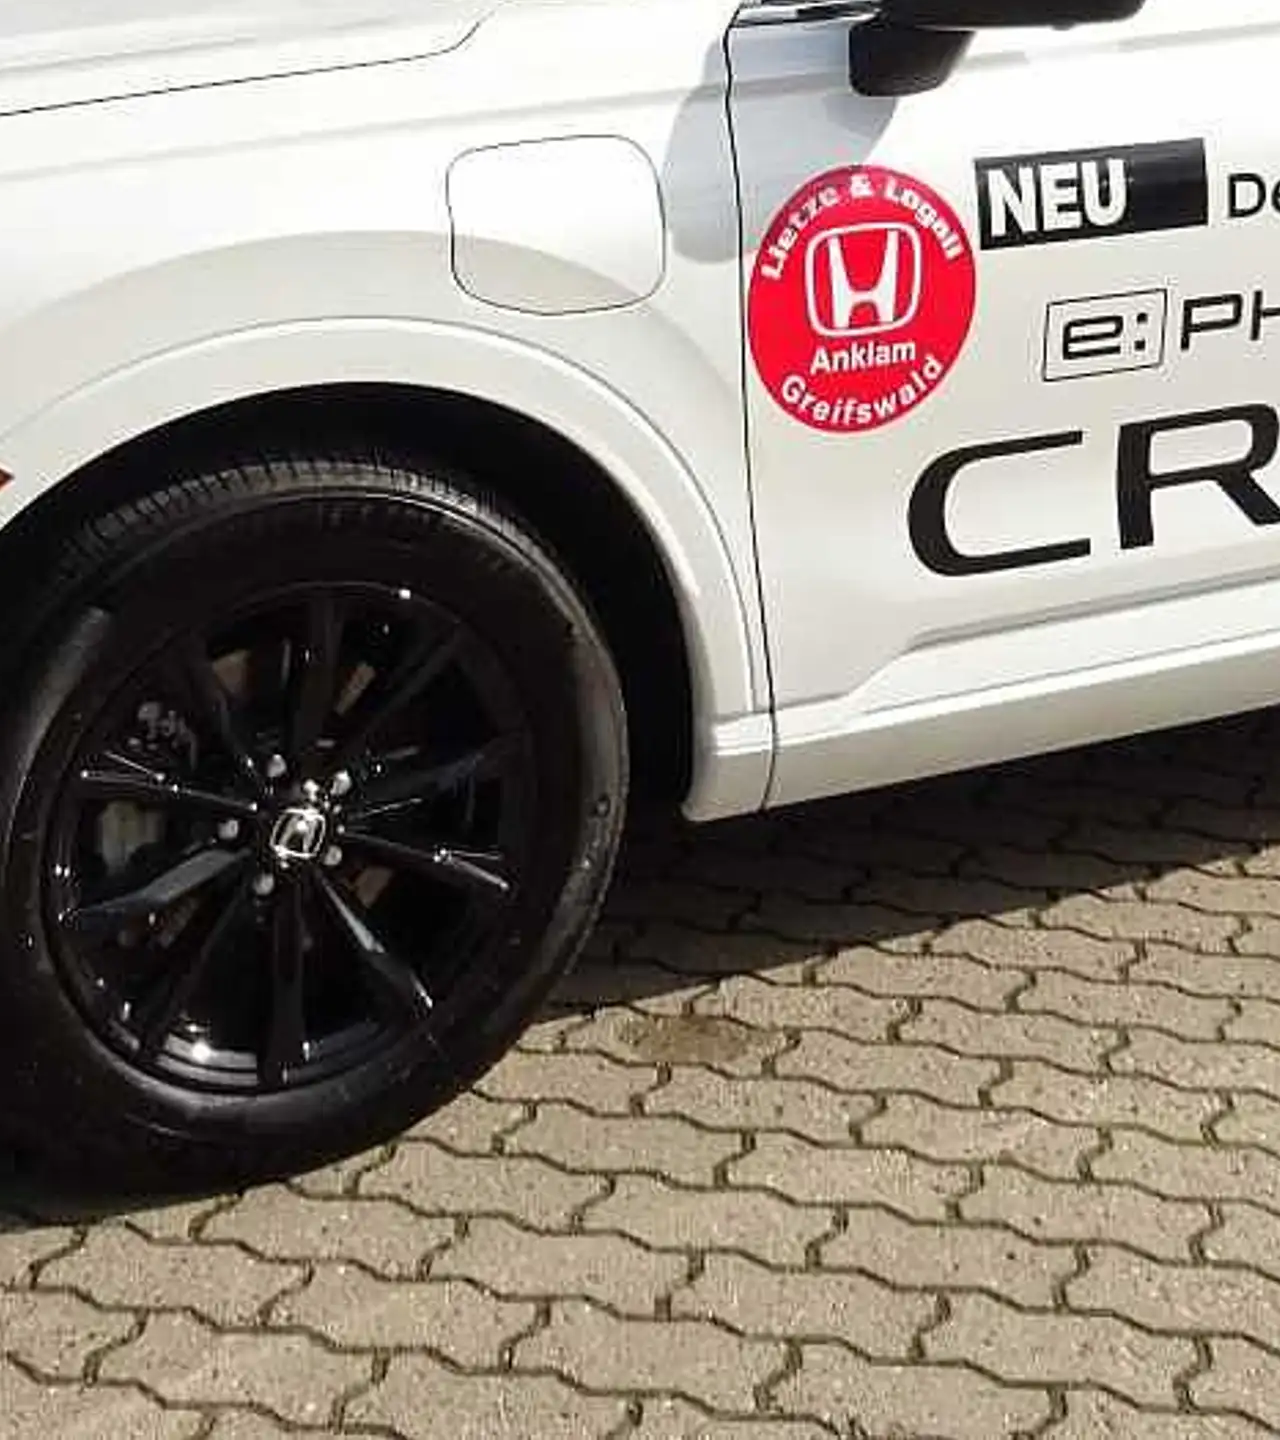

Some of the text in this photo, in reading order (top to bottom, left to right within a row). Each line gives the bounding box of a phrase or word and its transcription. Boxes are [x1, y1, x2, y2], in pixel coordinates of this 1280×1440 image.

[849, 173, 873, 199] &
[988, 157, 1128, 239] NEU
[809, 340, 918, 376] Anklam
[780, 353, 945, 427] Greifswald
